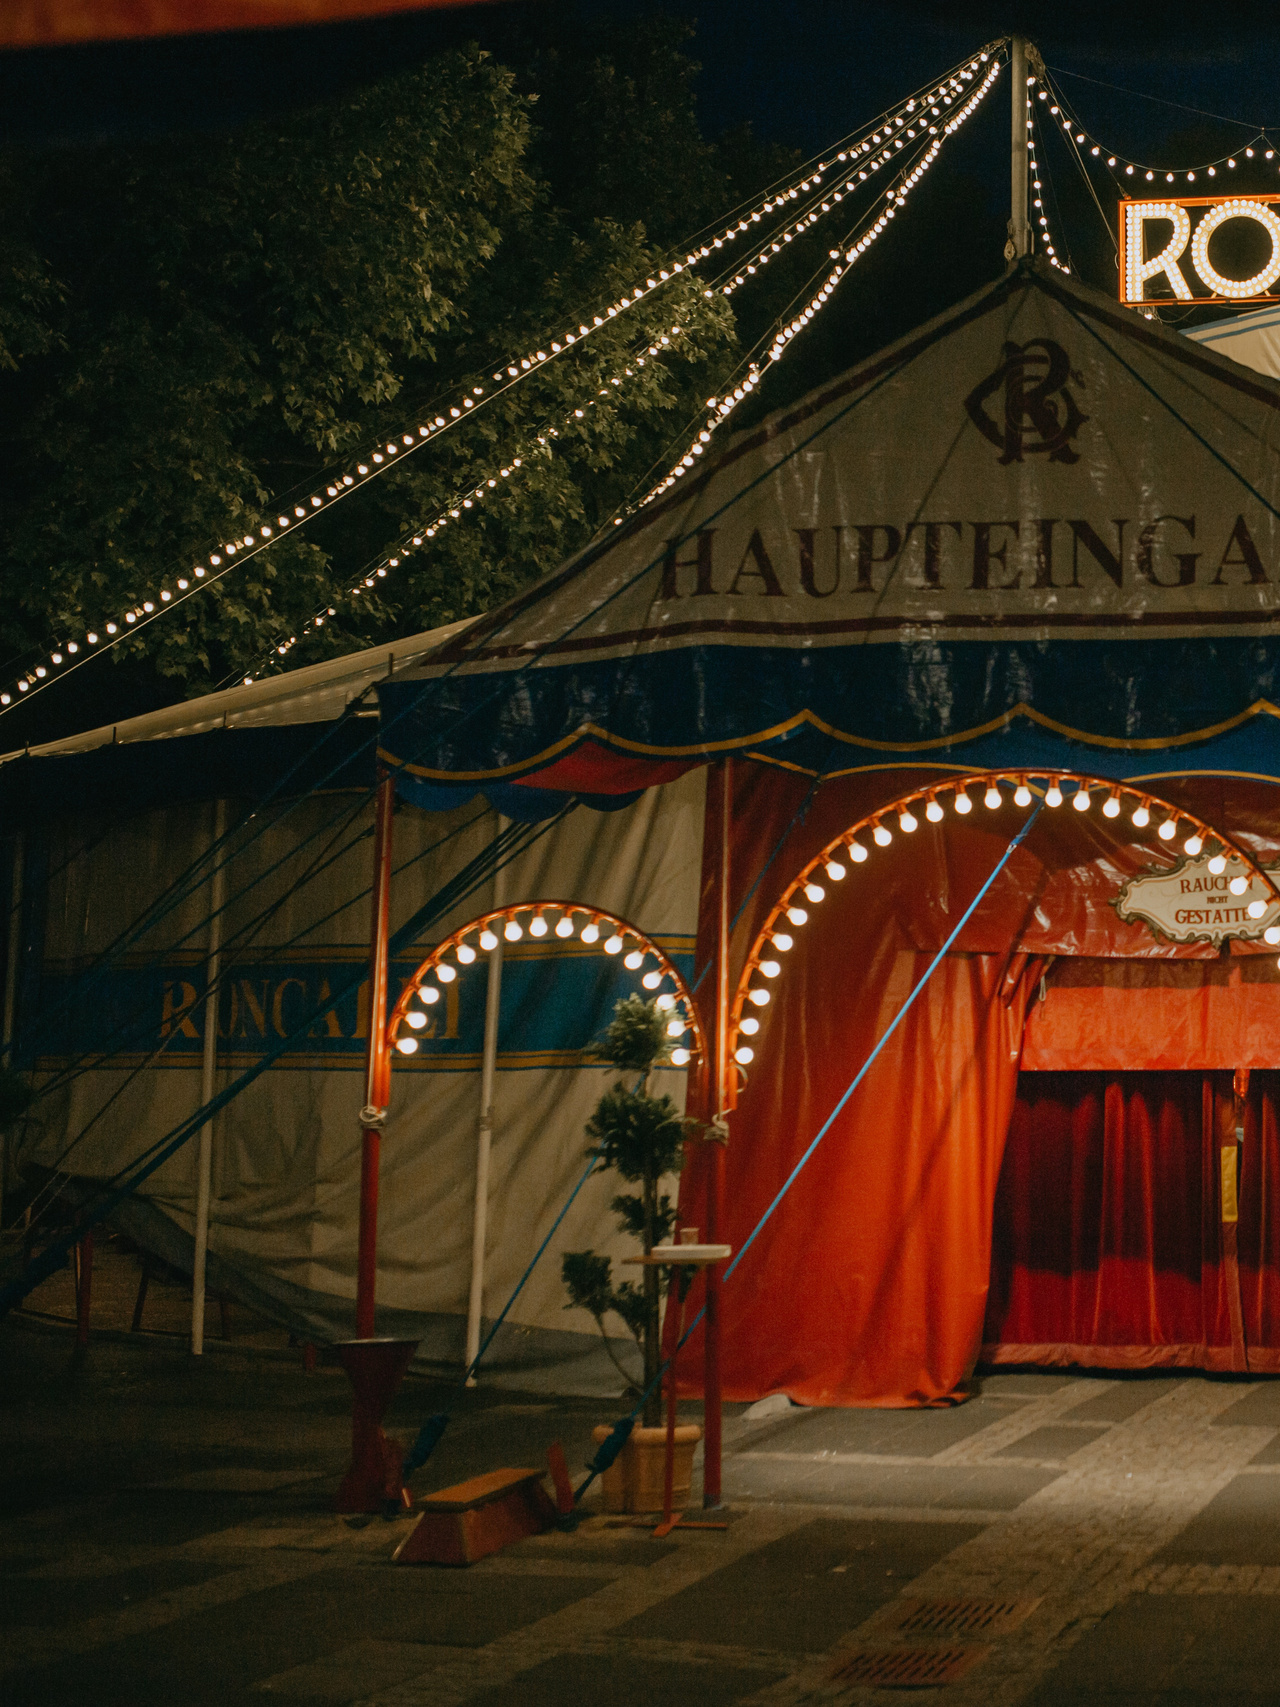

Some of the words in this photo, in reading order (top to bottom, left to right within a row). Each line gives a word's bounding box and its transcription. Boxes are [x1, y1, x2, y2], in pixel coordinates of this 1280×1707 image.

[1180, 875, 1253, 894] RAUCH
[1207, 896, 1228, 904] NICHT
[1175, 906, 1261, 924] GESTATTE
